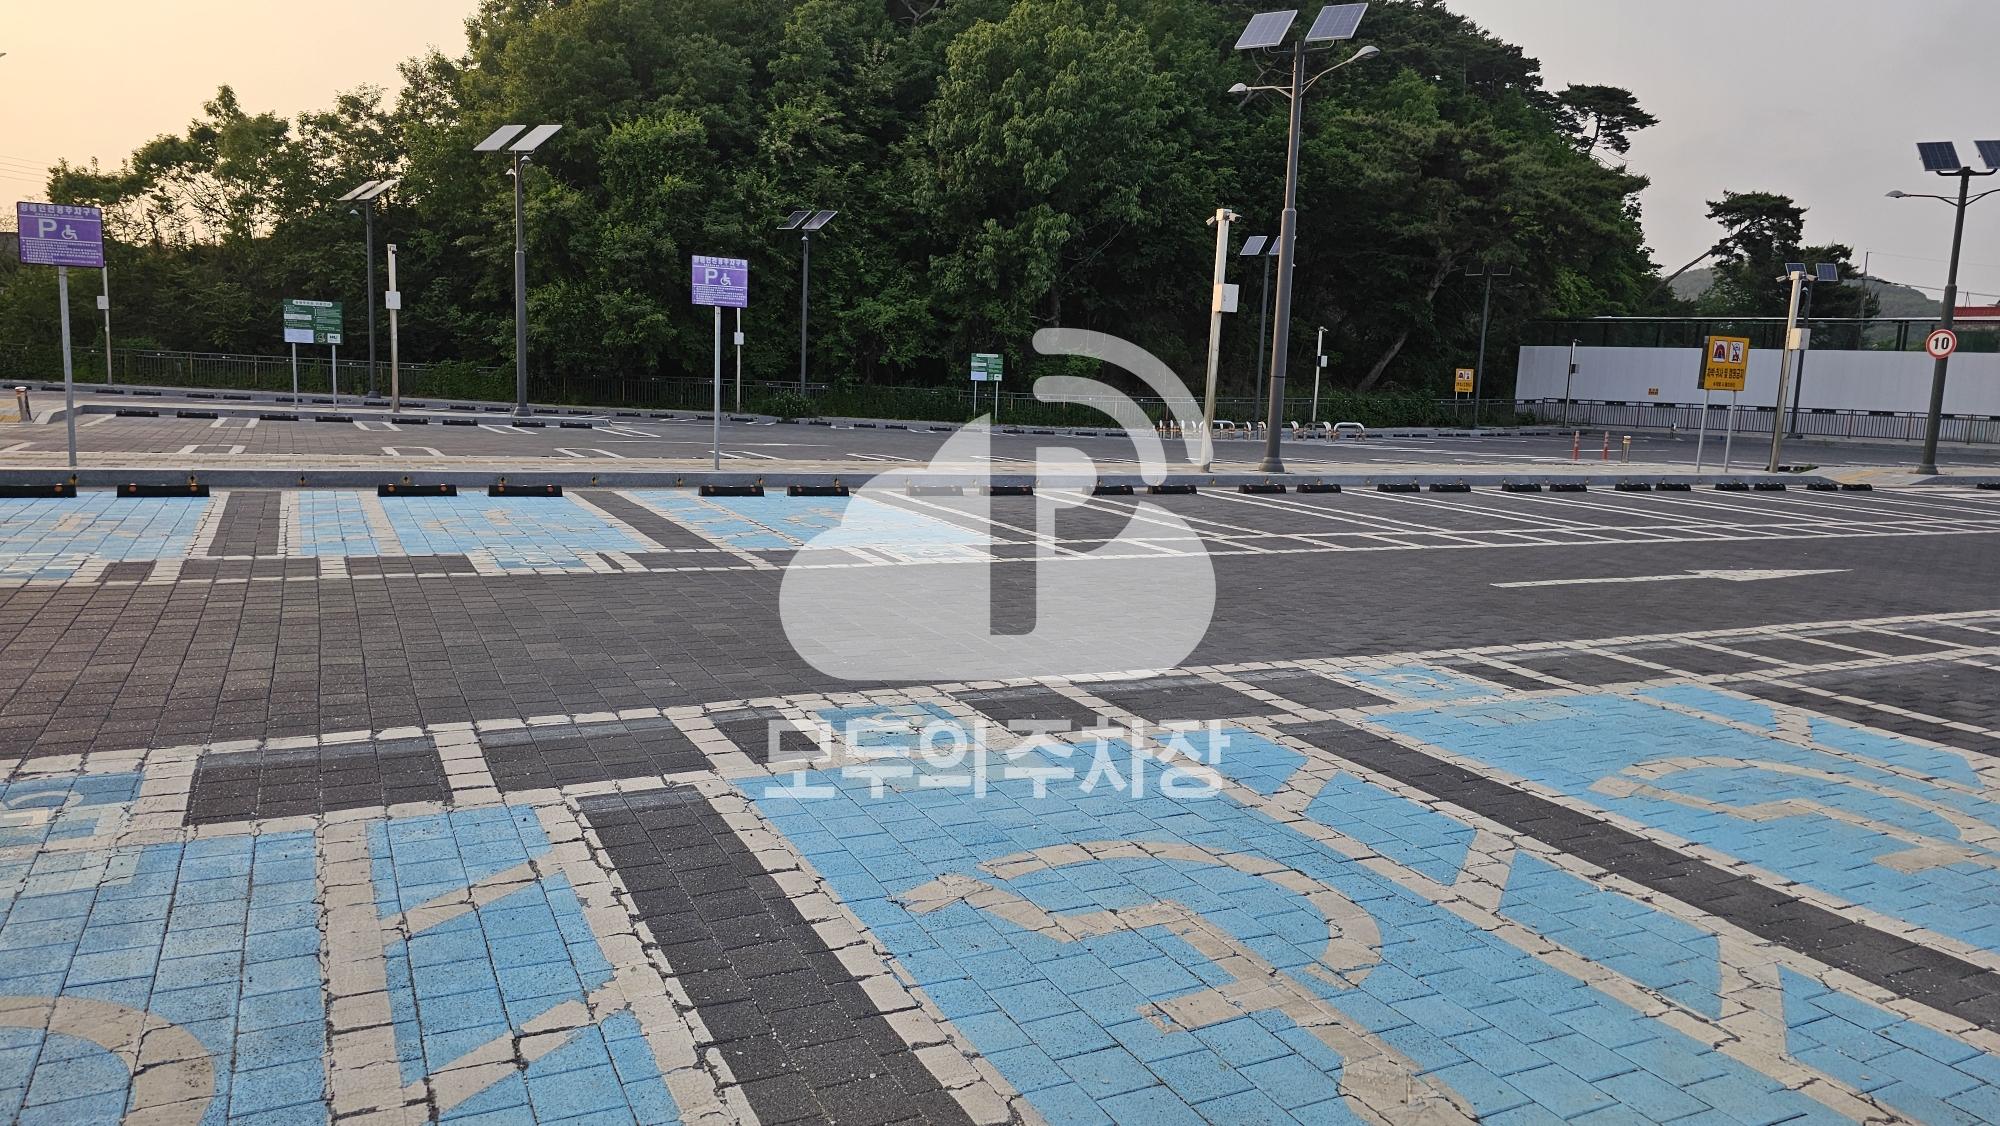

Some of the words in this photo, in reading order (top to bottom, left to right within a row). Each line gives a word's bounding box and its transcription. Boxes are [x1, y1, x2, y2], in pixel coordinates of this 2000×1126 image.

[38, 218, 58, 239] P
[694, 256, 747, 266] 인전주차구
[705, 268, 718, 284] P
[1934, 337, 1950, 350] 10
